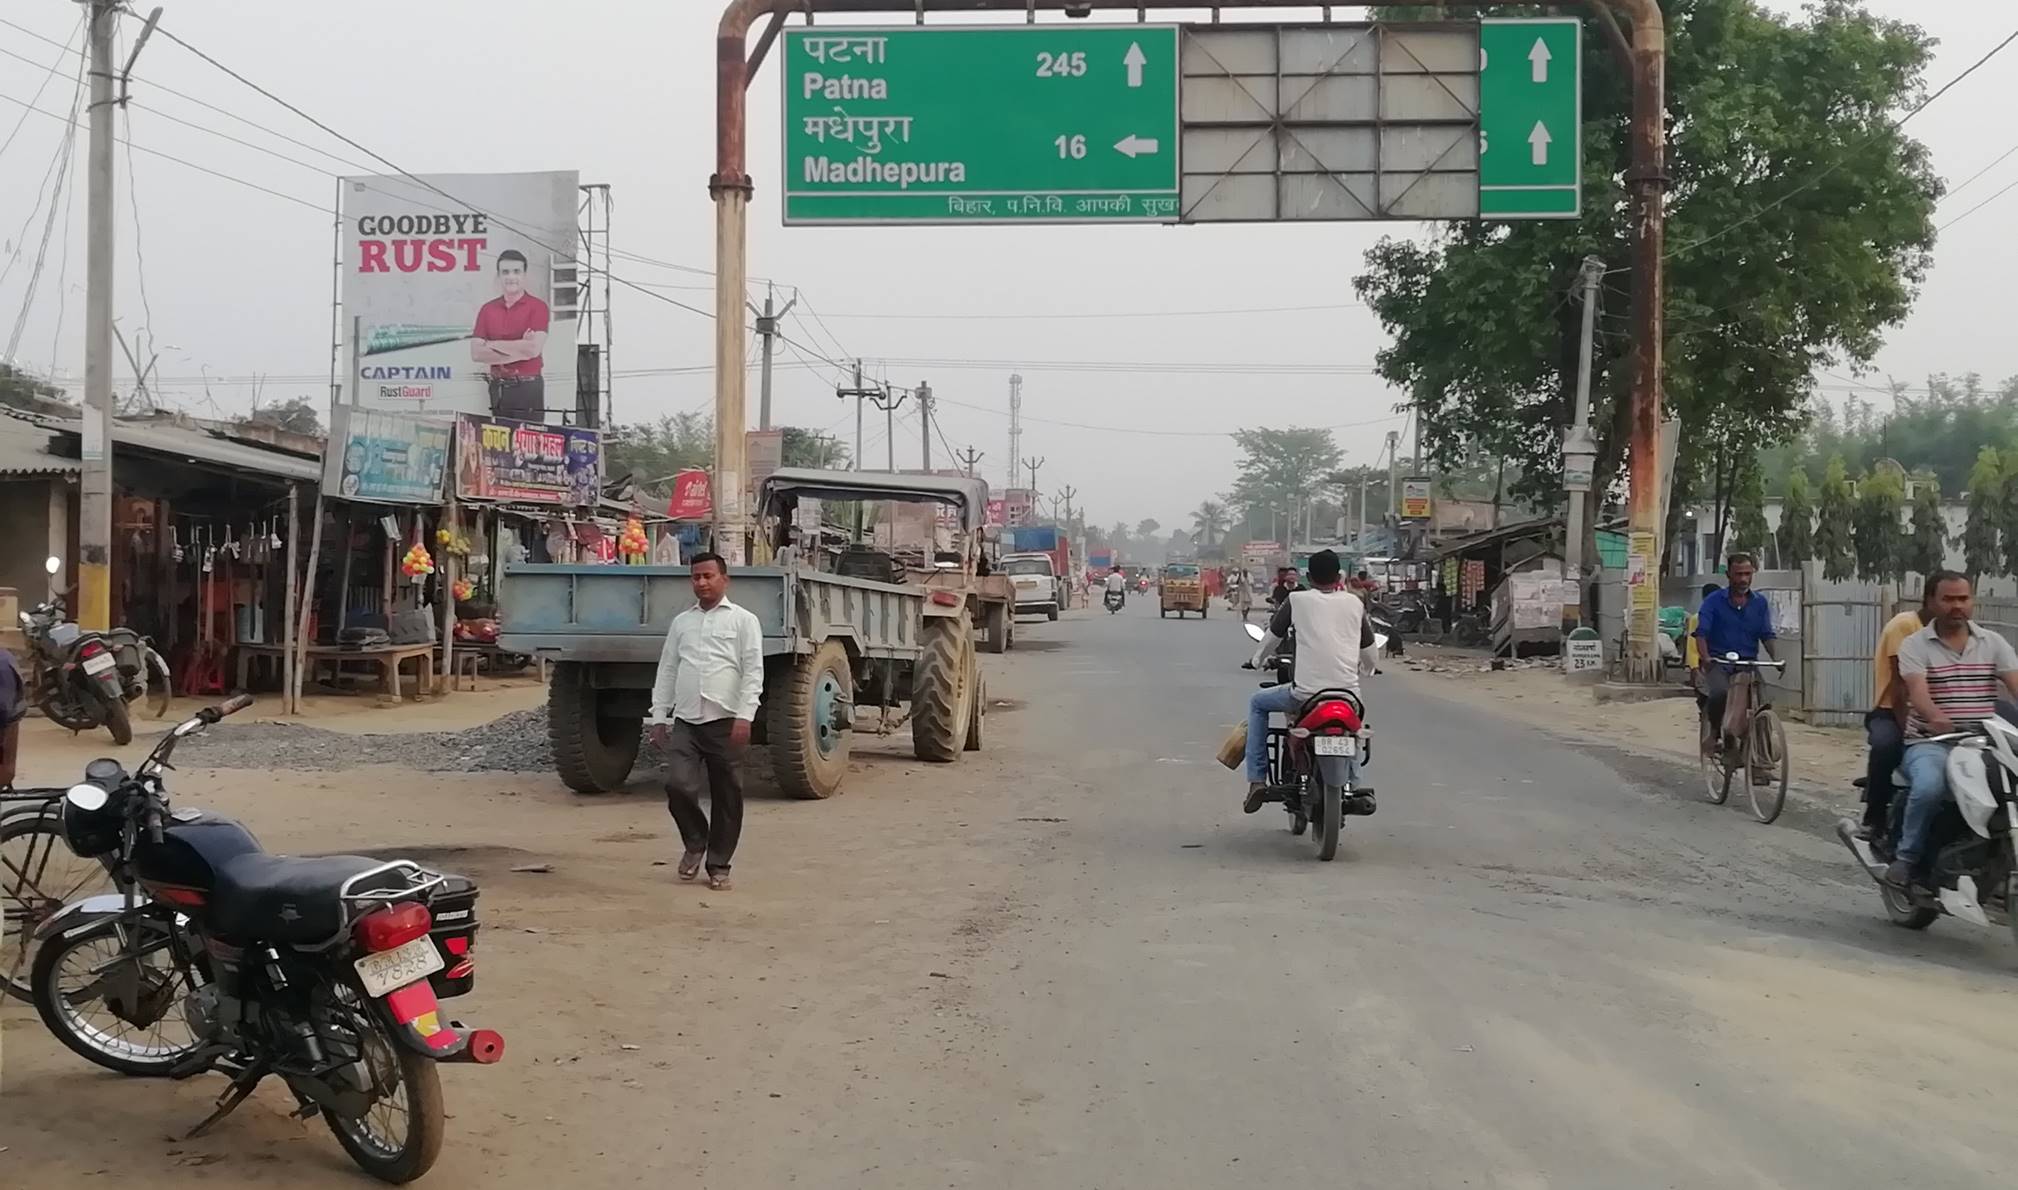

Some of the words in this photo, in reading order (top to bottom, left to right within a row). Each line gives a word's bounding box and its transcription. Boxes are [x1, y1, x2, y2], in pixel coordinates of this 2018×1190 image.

[803, 37, 888, 64] पटना
[1036, 51, 1087, 77] 245
[804, 72, 888, 99] Patna
[803, 105, 914, 154] मधेपुरा
[1055, 134, 1087, 160] 16
[804, 156, 966, 189] Madhepura
[1076, 197, 1132, 213] आपकी
[1141, 197, 1180, 217] सुख
[358, 214, 487, 236] GOODBYE
[358, 238, 487, 272] RUST
[360, 366, 451, 380] CAPTAIN
